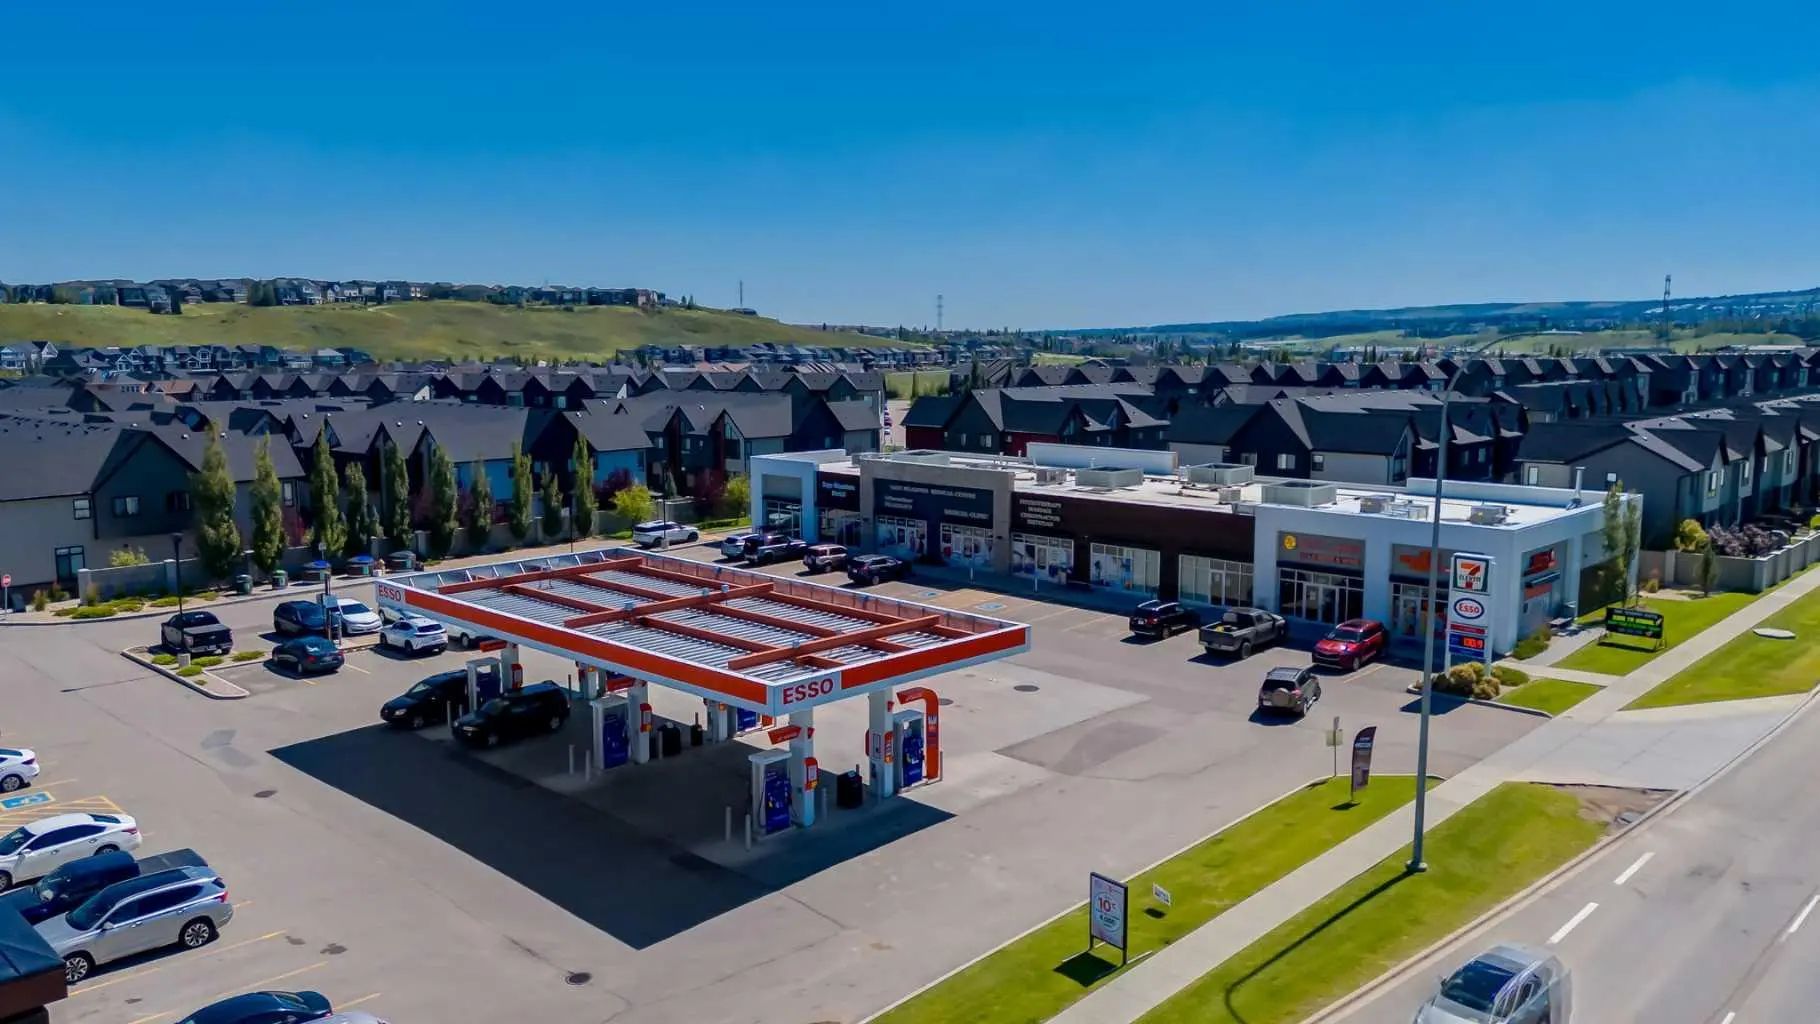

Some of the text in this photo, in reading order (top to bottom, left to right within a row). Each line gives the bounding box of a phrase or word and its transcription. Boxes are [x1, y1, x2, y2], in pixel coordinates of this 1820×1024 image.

[1460, 563, 1481, 577] 7
[379, 584, 402, 602] ESSO
[783, 678, 834, 705] ESSO
